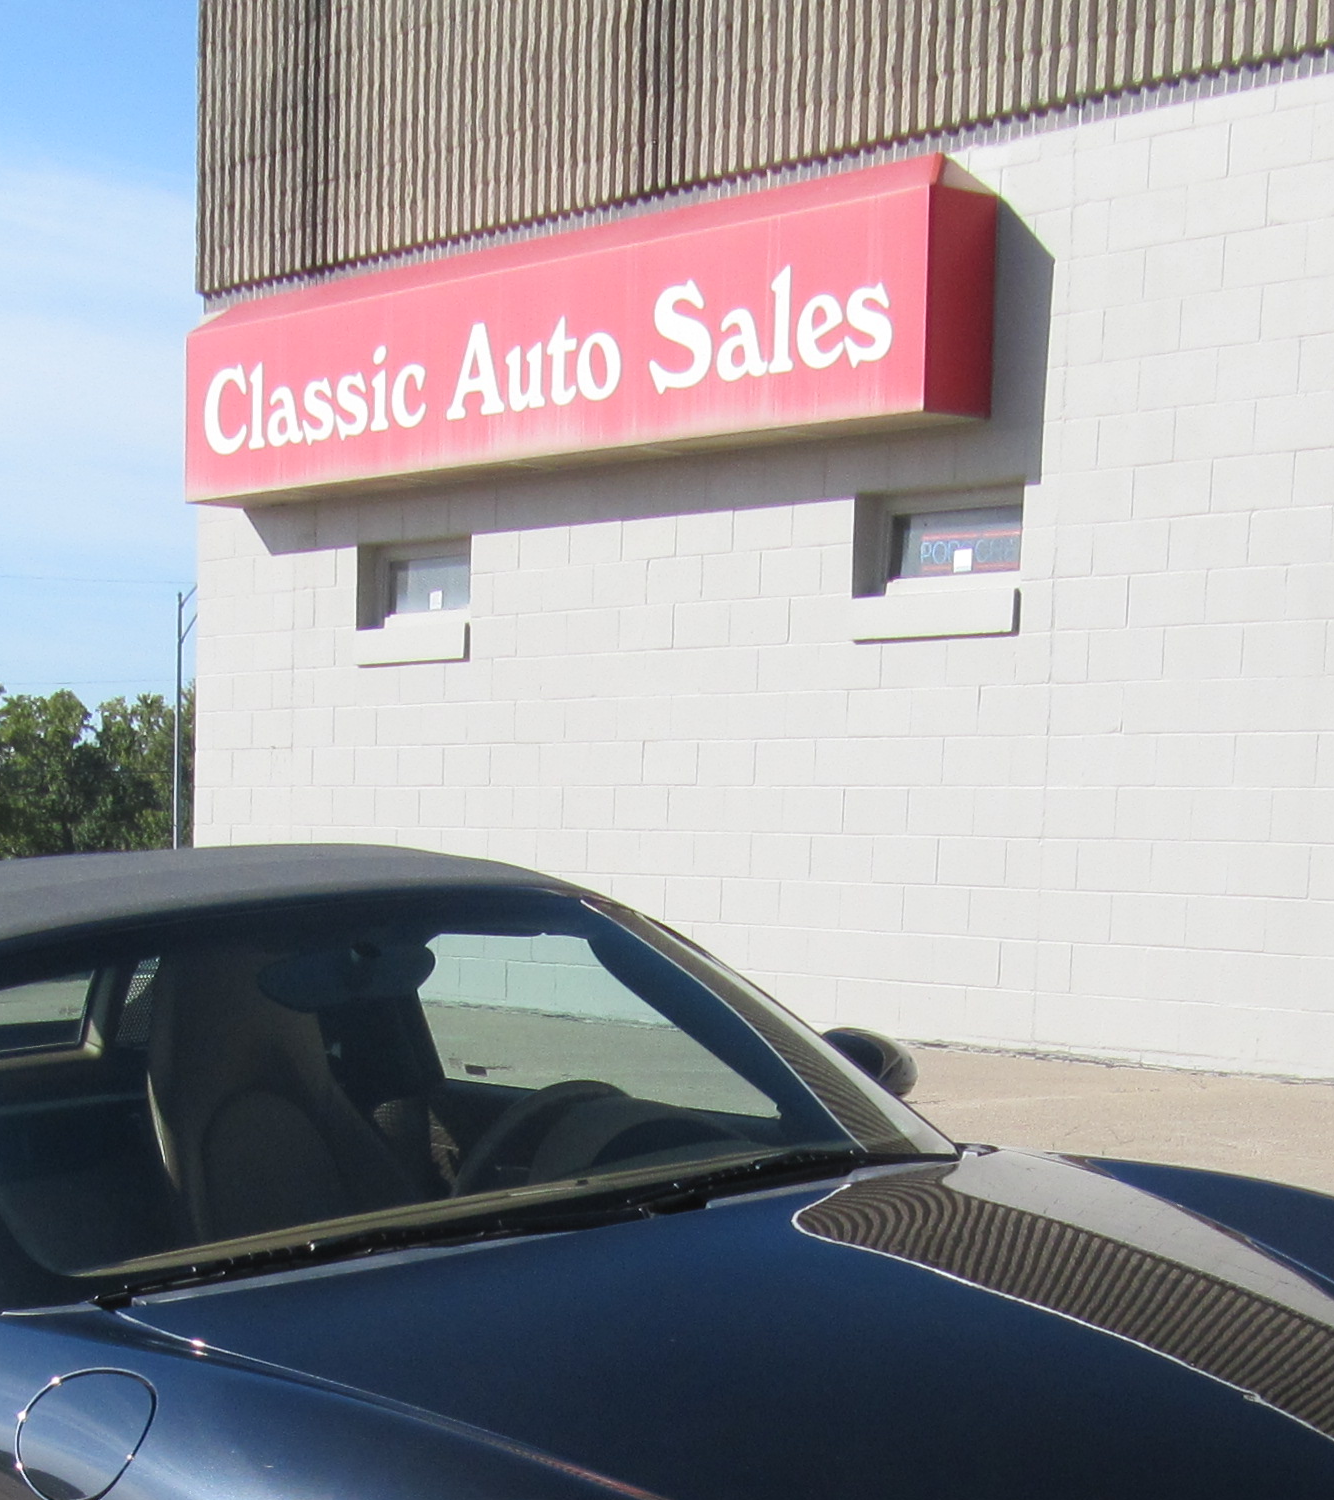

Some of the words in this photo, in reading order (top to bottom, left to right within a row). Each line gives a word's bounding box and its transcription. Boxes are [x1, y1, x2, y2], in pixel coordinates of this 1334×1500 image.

[203, 344, 427, 456] Classic
[446, 315, 622, 421] Auto
[648, 264, 894, 396] Sales
[919, 538, 1016, 564] PORC
